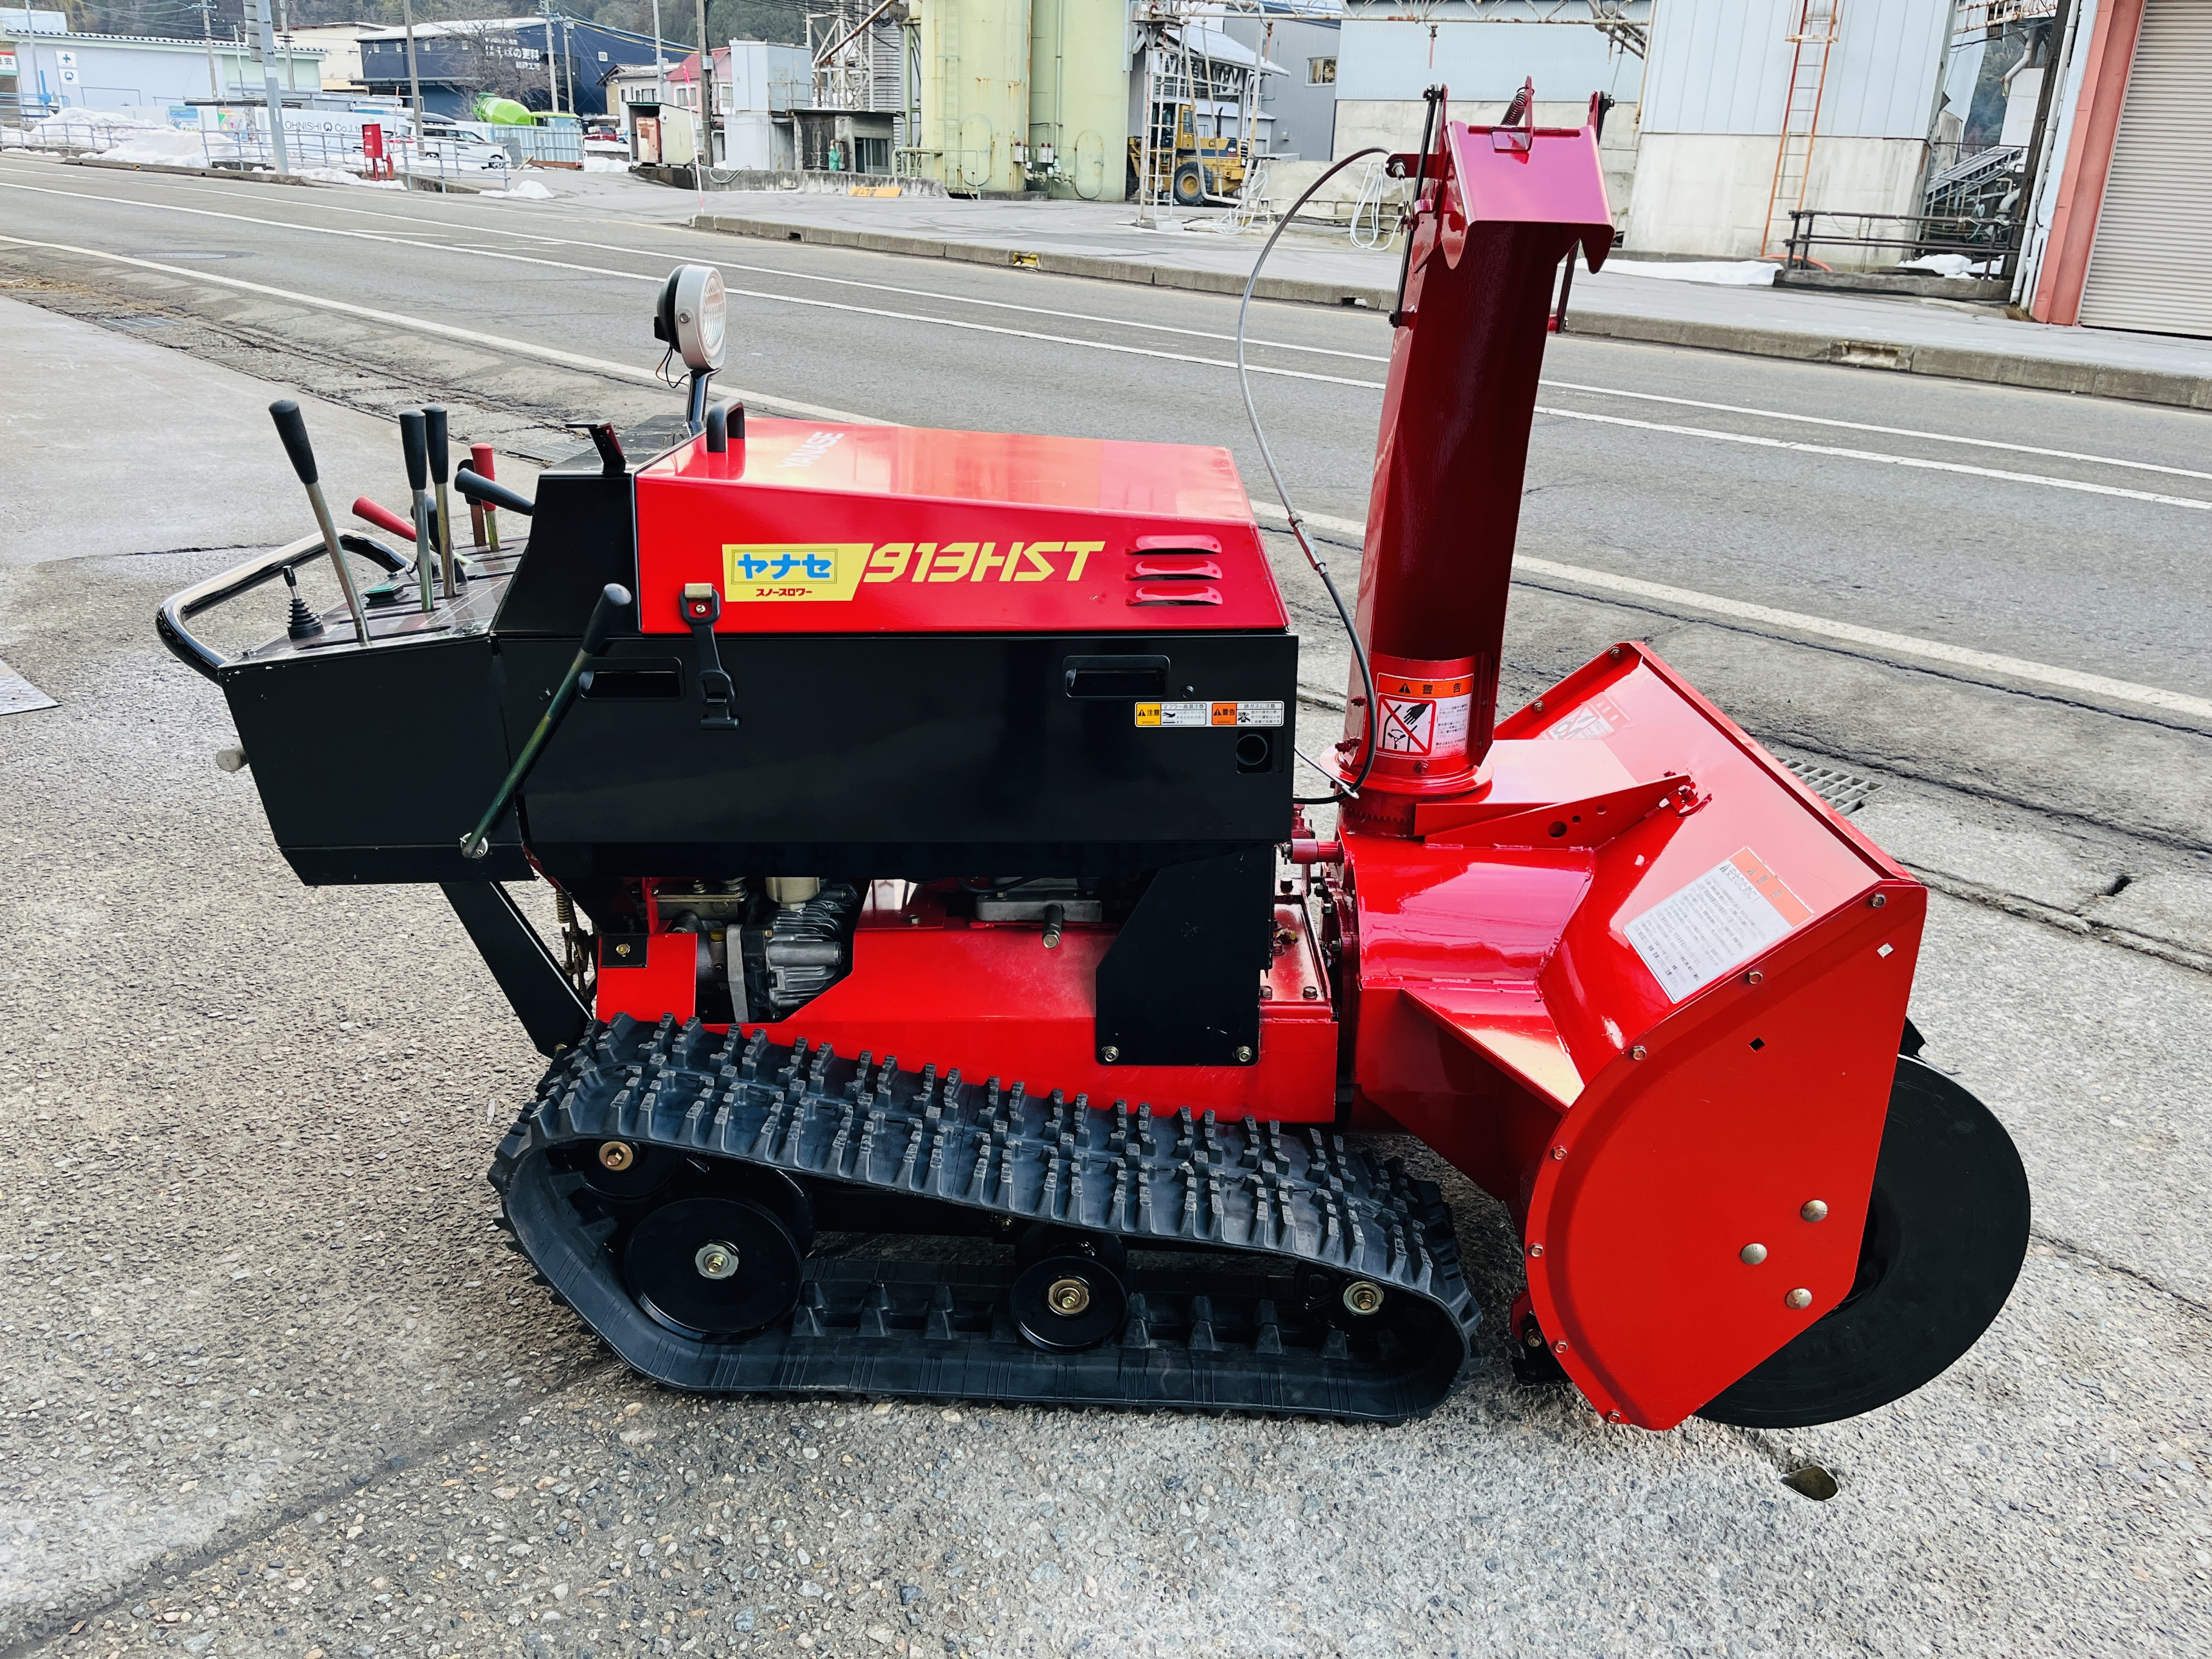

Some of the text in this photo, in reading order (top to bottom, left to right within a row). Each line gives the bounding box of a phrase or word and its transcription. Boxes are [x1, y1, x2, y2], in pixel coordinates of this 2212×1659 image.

[285, 121, 321, 131] OHNISHI
[775, 431, 845, 468] YANASE
[737, 553, 832, 580] ヤナセ
[863, 541, 1106, 583] 913HST
[756, 588, 812, 597] スノースロワー
[1423, 682, 1462, 695] 警告
